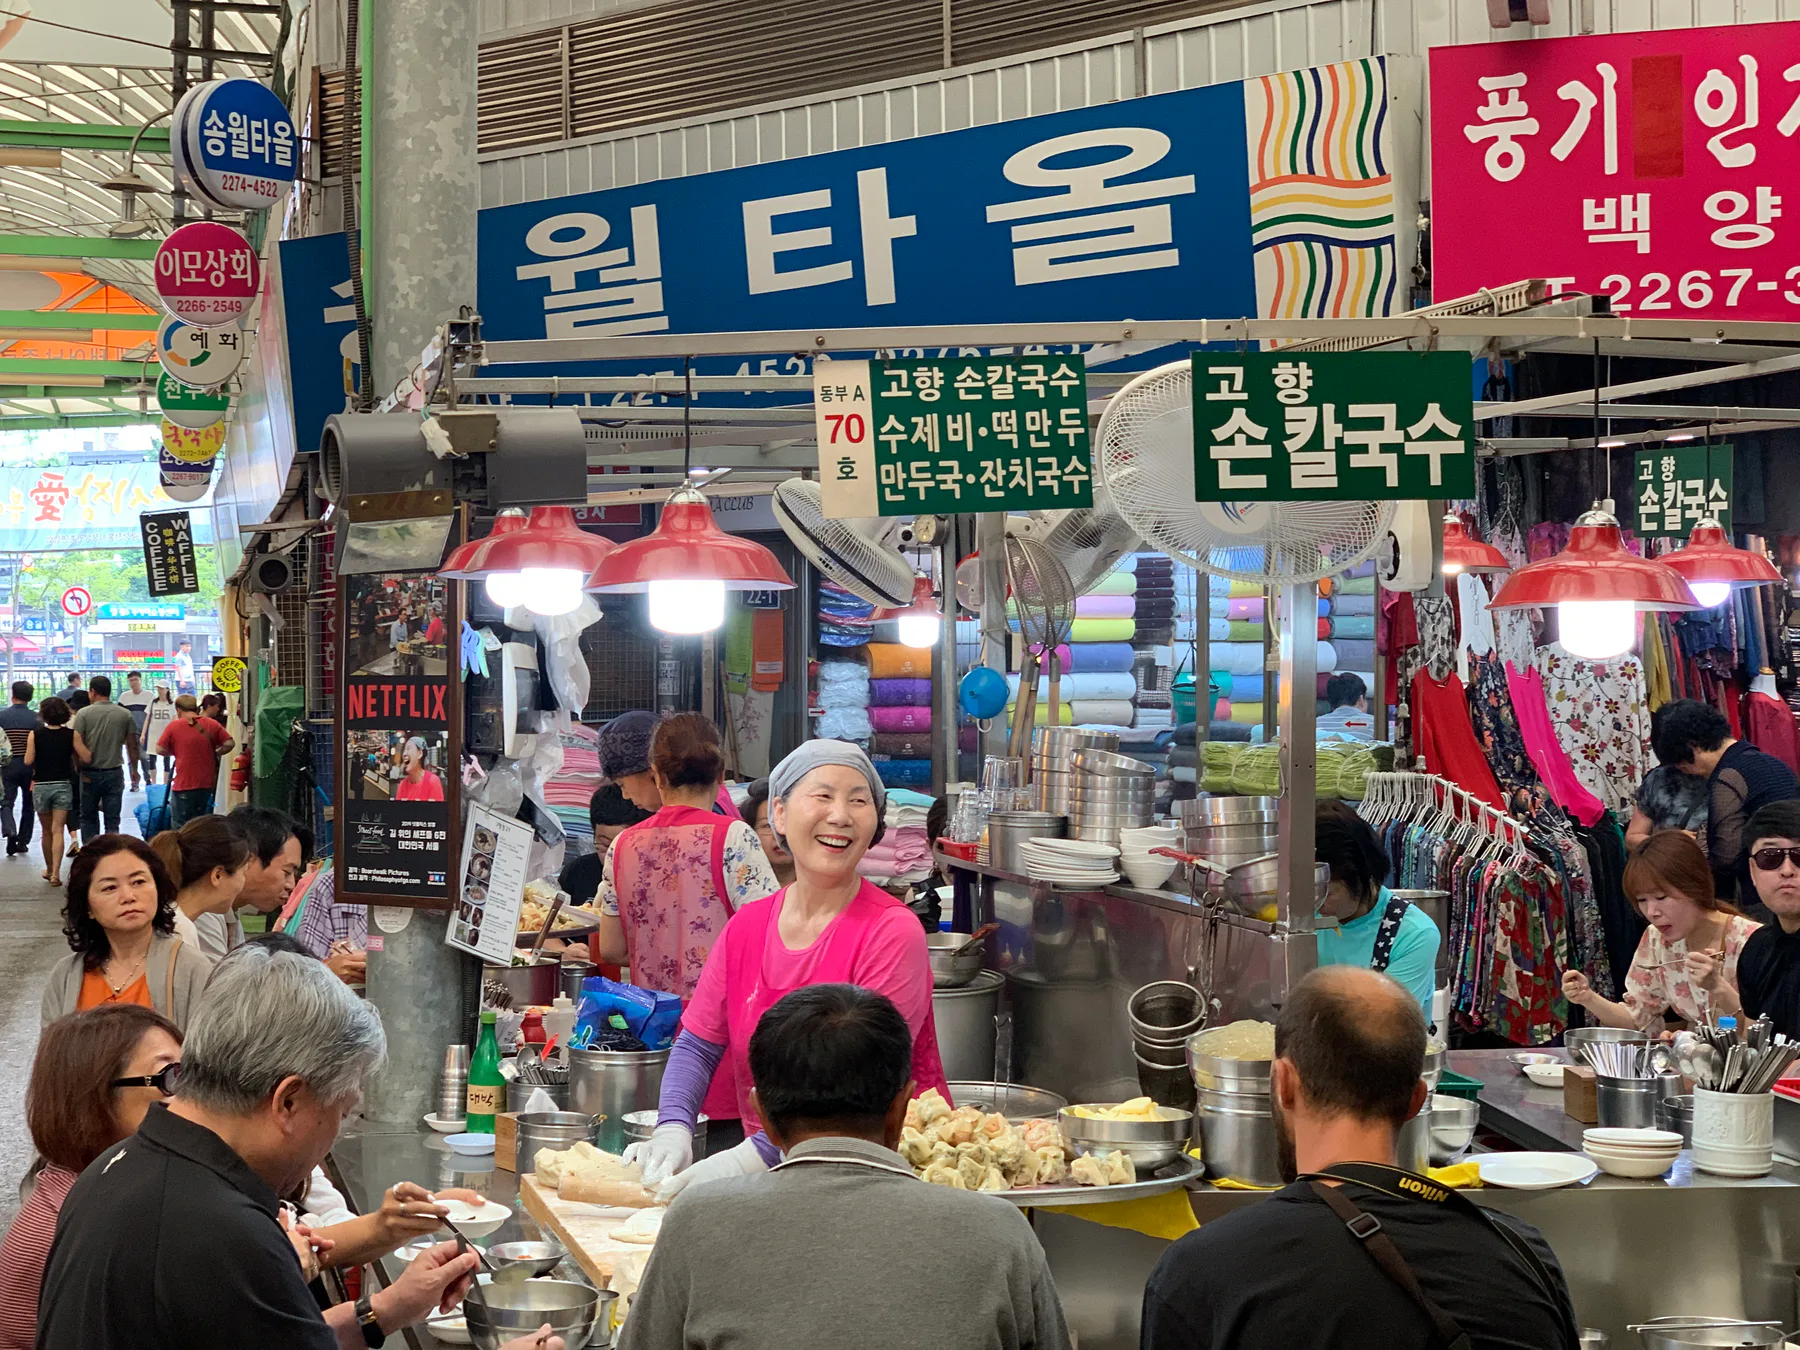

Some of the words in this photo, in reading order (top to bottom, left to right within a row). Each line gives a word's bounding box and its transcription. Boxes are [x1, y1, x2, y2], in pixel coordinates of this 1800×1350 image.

[203, 110, 293, 167] 송월타올
[1463, 62, 1618, 182] 풍기
[222, 174, 278, 198] 2274-4522
[159, 248, 252, 287] 이모상회
[177, 300, 242, 313] 2266-2549
[820, 385, 848, 402] 동부
[853, 384, 865, 402] A
[880, 365, 945, 402] 고향
[953, 363, 1080, 400] 손칼국수
[1205, 361, 1313, 405] 고향
[824, 413, 865, 444] 70
[1209, 402, 1465, 490] 손칼국수
[836, 456, 858, 481] 호
[1638, 456, 1676, 481] 고향
[1638, 478, 1729, 531] 손칼국수
[145, 521, 168, 592] COFFEE
[170, 518, 196, 589] WAFFLE
[154, 709, 170, 720] 86
[348, 684, 447, 721] NETFLIX
[1398, 1177, 1450, 1203] Nikon
